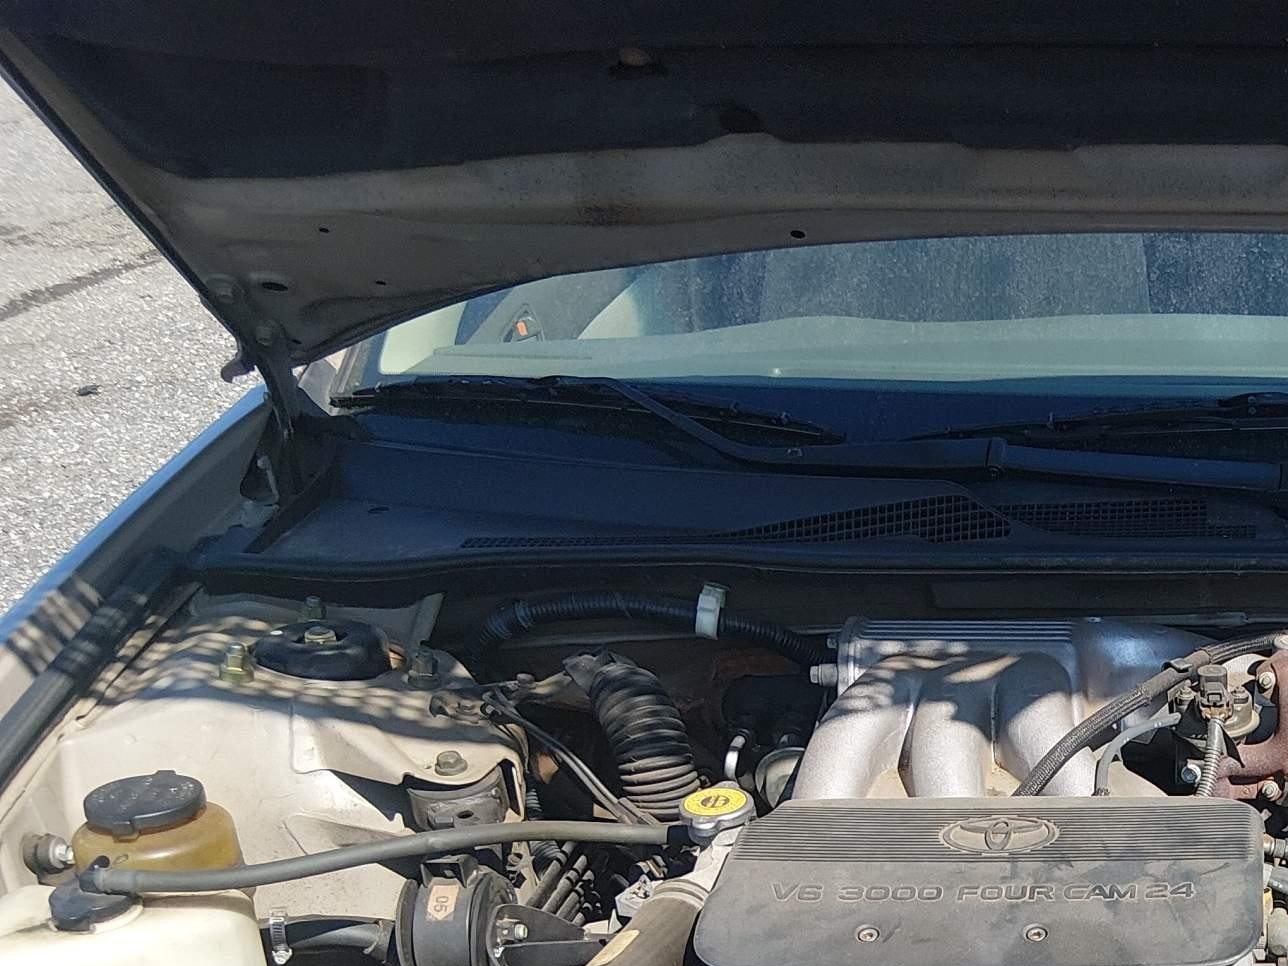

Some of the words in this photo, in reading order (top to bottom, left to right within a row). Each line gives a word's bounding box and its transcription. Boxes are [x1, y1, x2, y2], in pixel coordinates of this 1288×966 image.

[772, 883, 823, 901] V6
[837, 884, 943, 901] 3000
[958, 883, 1054, 901] FOUR
[1063, 883, 1138, 900] CAM
[1143, 881, 1194, 899] 24
[433, 895, 449, 913] 05
